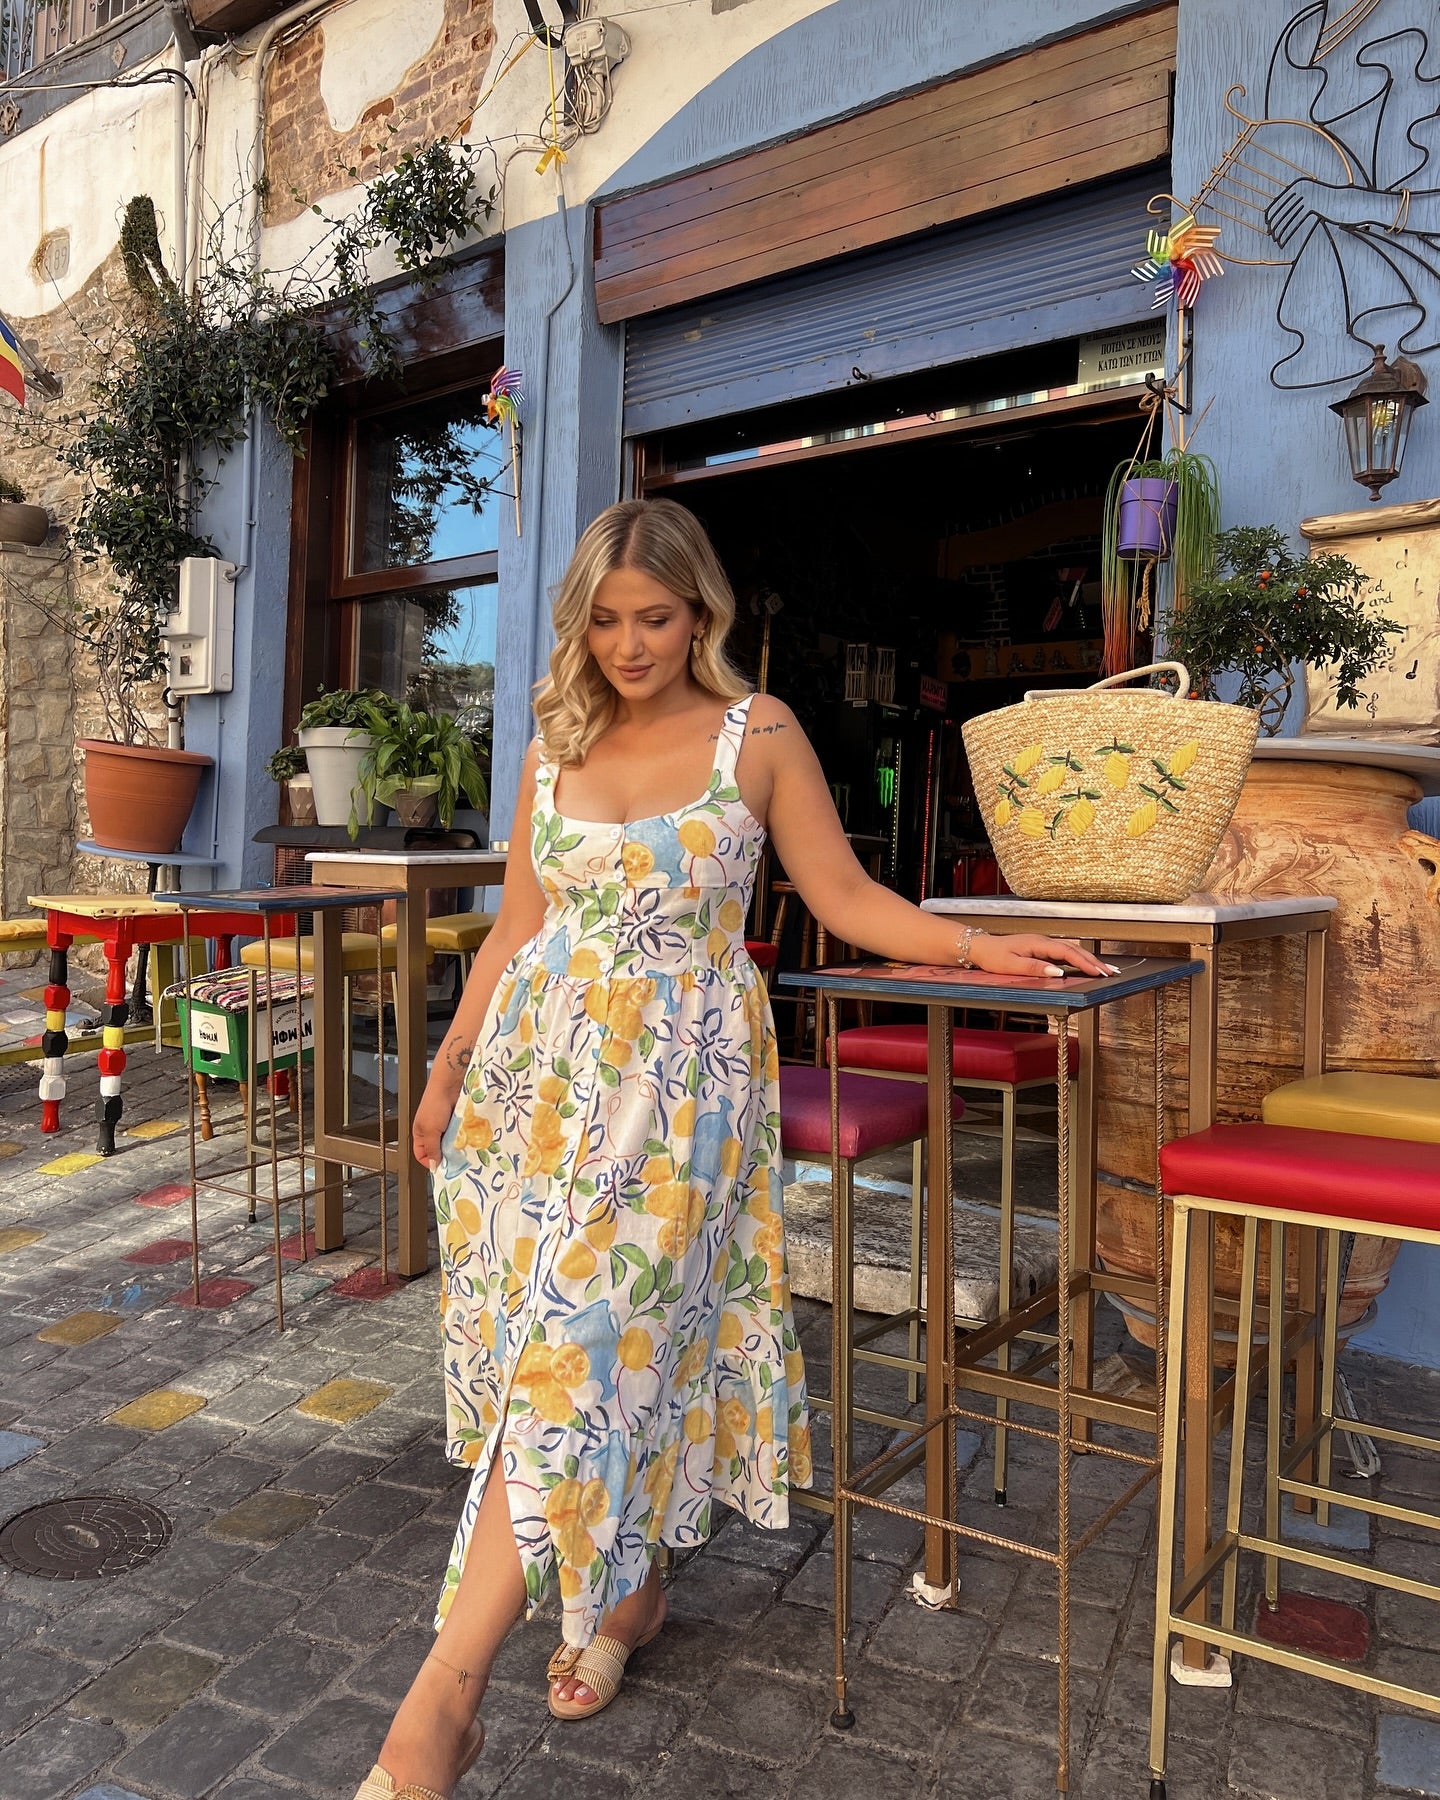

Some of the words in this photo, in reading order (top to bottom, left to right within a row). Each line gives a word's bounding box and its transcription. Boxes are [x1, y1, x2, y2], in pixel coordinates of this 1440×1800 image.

[1101, 340, 1126, 355] ΠΟΤΩΝ
[1126, 340, 1136, 350] ΣΕ
[1136, 332, 1161, 348] ΝΕΟΥΣ
[1098, 358, 1118, 372] ΚΑΤΩ
[1119, 355, 1134, 368] ΤΩΝ
[1135, 353, 1142, 365] 17
[1143, 349, 1163, 364] ΕΤΩΝ
[1368, 590, 1395, 608] and
